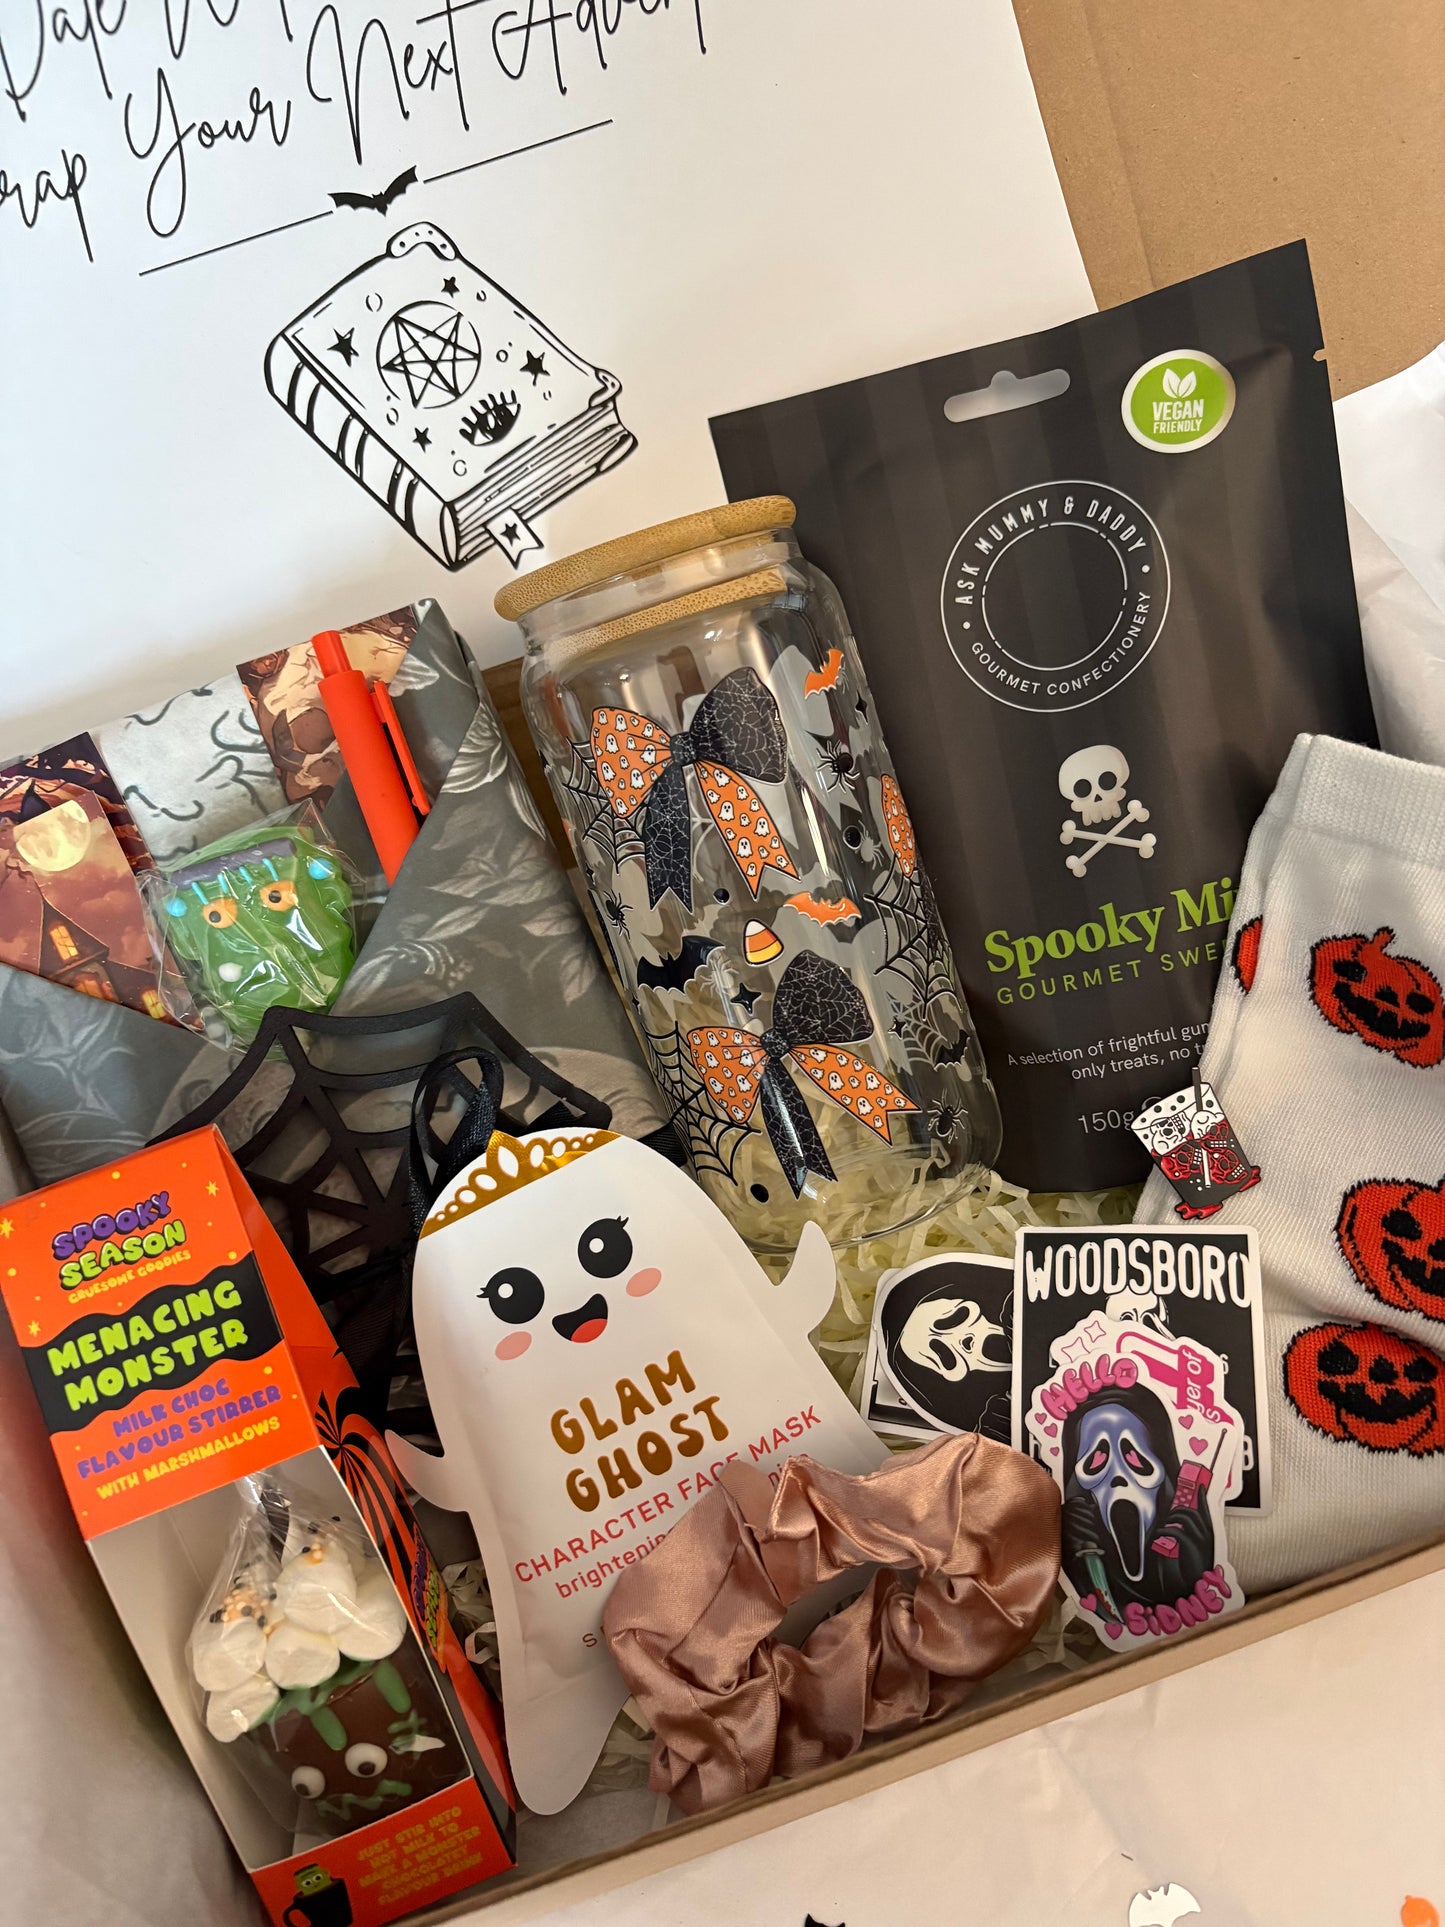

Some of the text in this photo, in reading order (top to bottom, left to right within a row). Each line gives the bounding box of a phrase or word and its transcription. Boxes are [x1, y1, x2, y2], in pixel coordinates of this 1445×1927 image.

[0, 149, 94, 263] rap
[124, 67, 292, 238] Your
[307, 0, 492, 165] Next
[1152, 399, 1204, 421] VEGAN
[1153, 419, 1203, 434] FRIENDLY
[955, 496, 1146, 605] ASK MUMMY & DADDY
[971, 591, 1151, 696] GOURMET CONFECTIONERY
[984, 877, 1239, 979] Spooky Mi
[996, 960, 1143, 1005] GOURMET
[1007, 1053, 1018, 1066] A
[1020, 1046, 1084, 1066] selection
[1088, 1040, 1104, 1058] of
[1108, 1026, 1177, 1053] frightful
[1071, 1062, 1106, 1081] only
[1110, 1052, 1165, 1074] treats,
[1170, 1046, 1190, 1061] no
[1077, 1108, 1135, 1134] 150g
[53, 1190, 170, 1261] SPOOKY
[59, 1219, 187, 1291] SEASON
[68, 1250, 192, 1304] GRUESOME GOODIES
[1025, 1238, 1252, 1308] WOODSBORO
[47, 1280, 243, 1377] MENACING
[1182, 1348, 1202, 1376] of
[64, 1318, 249, 1412] MONSTER
[1040, 1353, 1139, 1421] HELLO
[77, 1384, 282, 1479] FLAVOUR STIRRER
[112, 1378, 231, 1438] MILK CHOC
[550, 1349, 697, 1455] GLAM
[96, 1416, 281, 1500] WITH MARSHMALLOWS
[565, 1396, 730, 1513] GHOST
[514, 1491, 675, 1583] CHARACTER
[748, 1405, 822, 1463] MASK
[358, 1806, 461, 1861] JUST STIR INTO
[415, 1825, 481, 1863] MONSTER
[438, 1822, 459, 1836] TO
